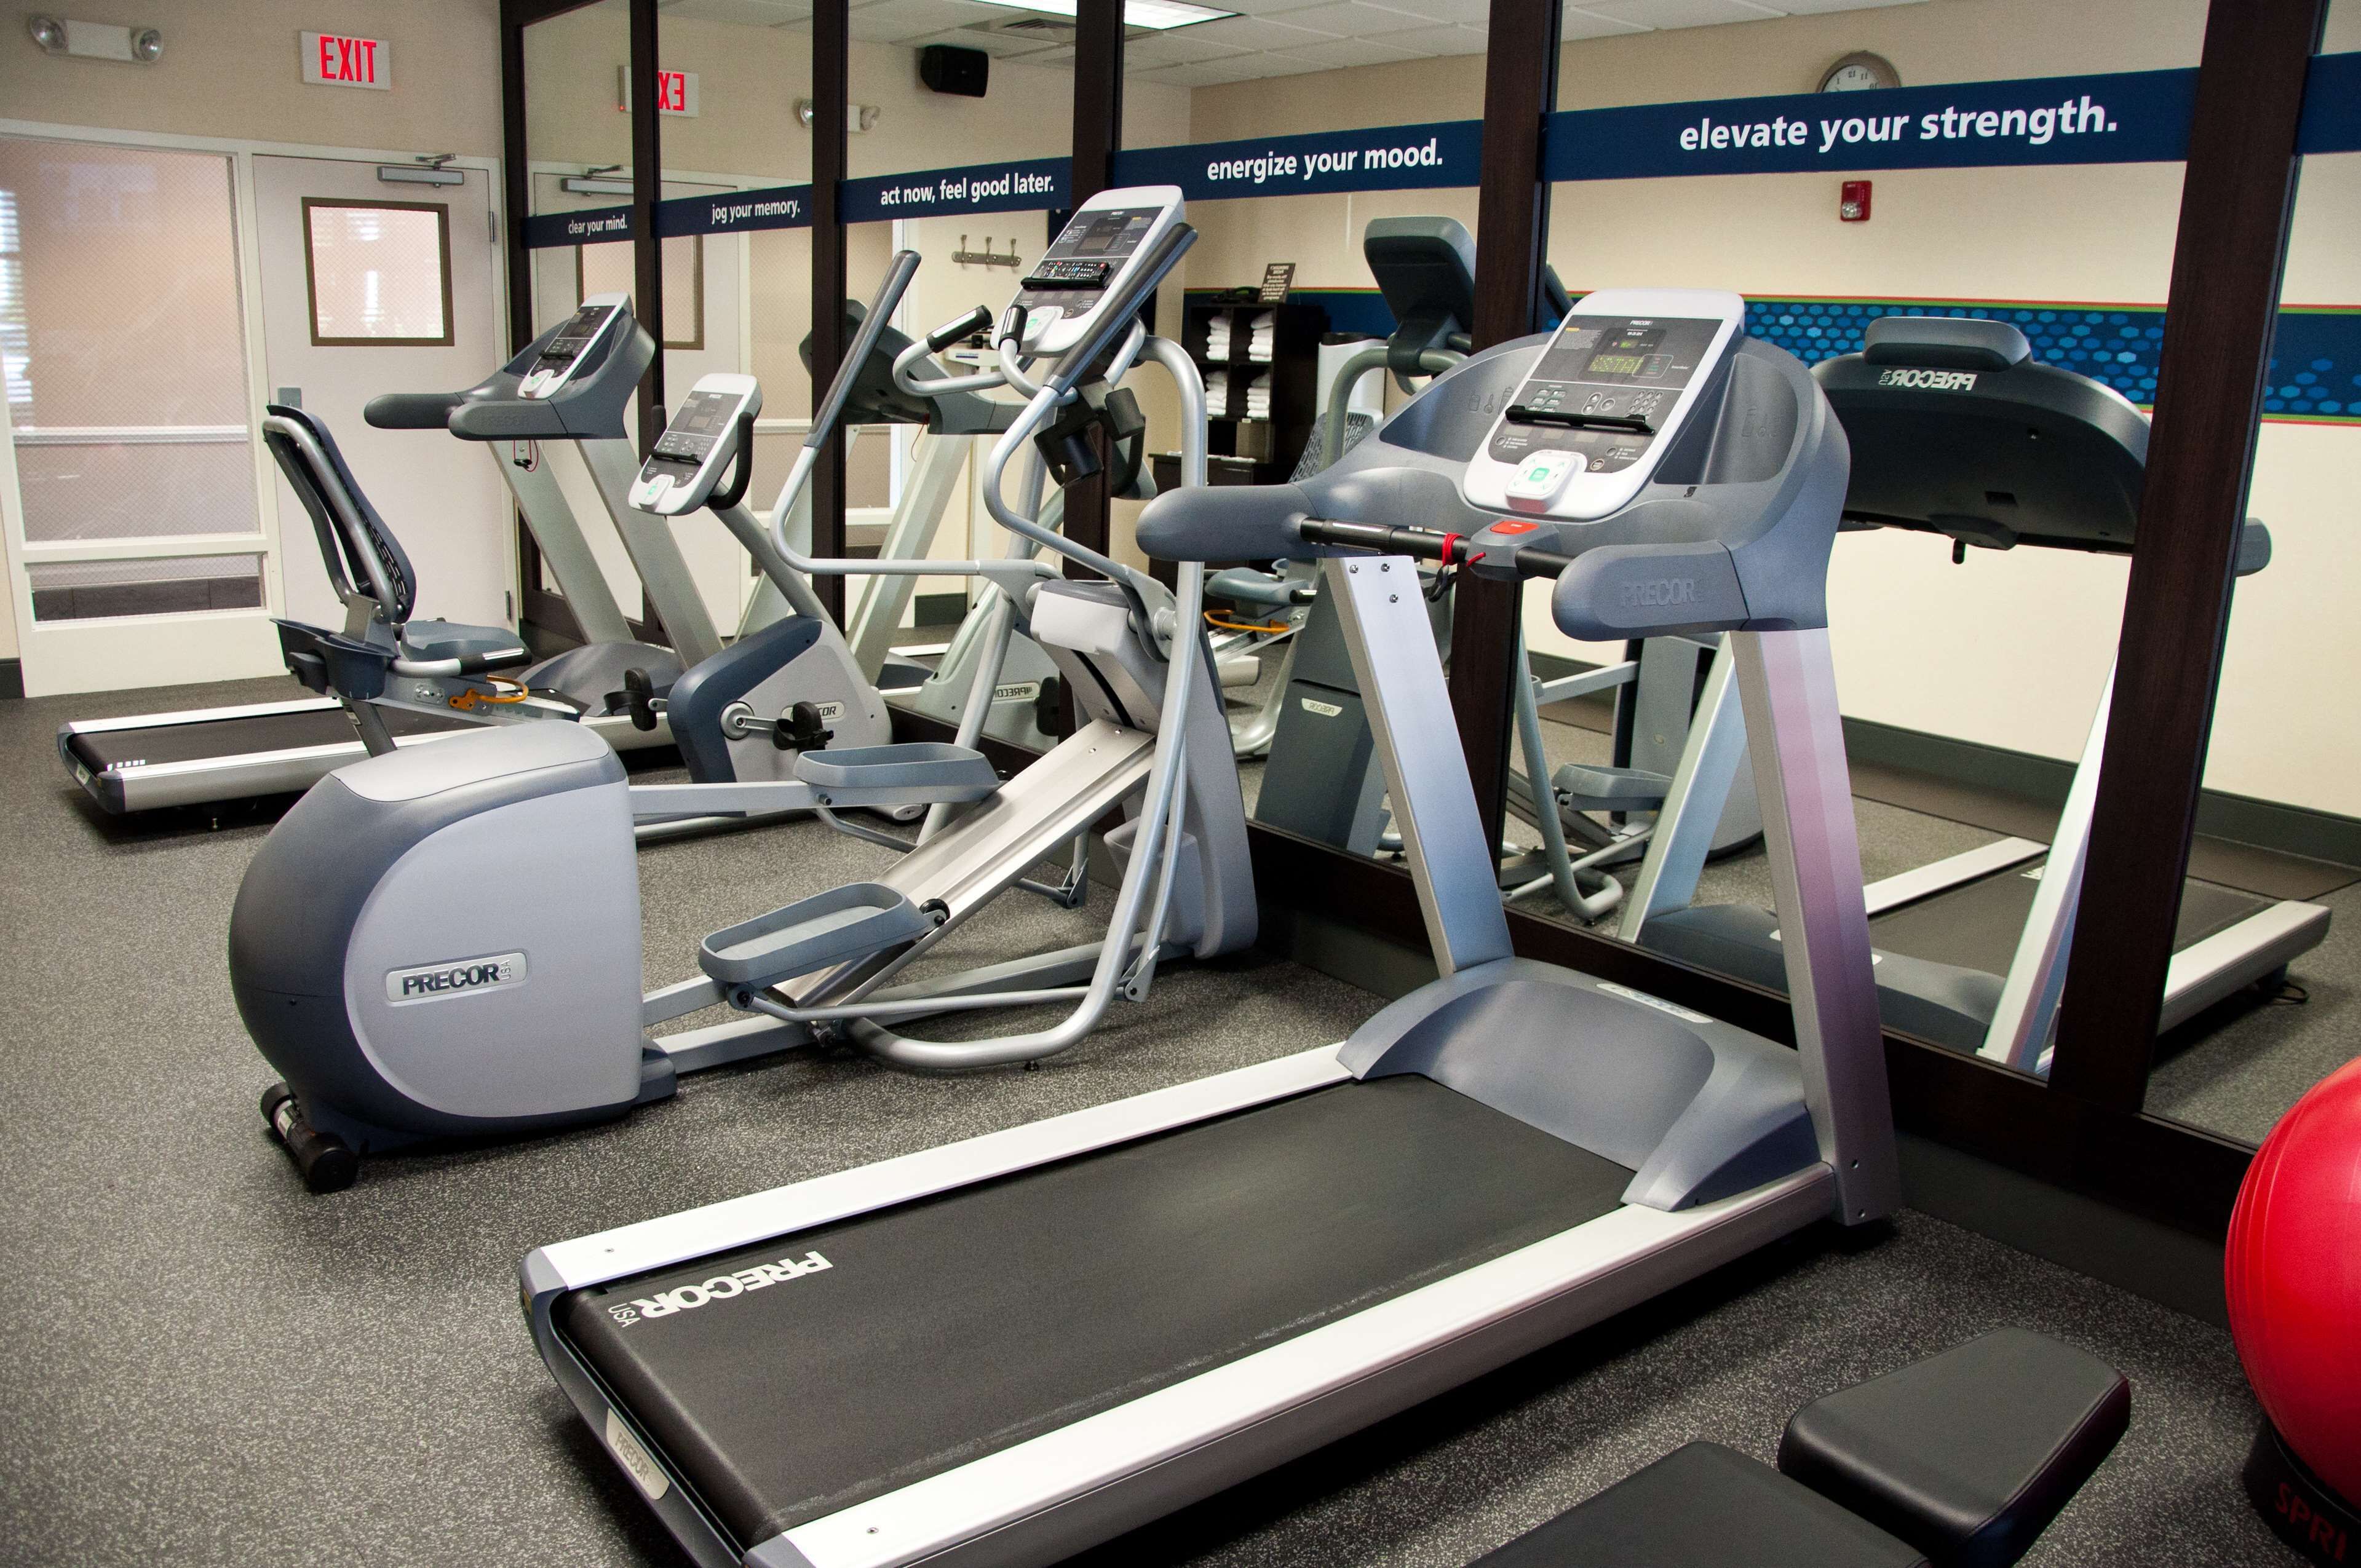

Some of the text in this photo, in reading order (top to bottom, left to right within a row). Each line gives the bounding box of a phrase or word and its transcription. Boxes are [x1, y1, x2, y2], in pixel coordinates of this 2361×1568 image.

[319, 35, 377, 83] EXIT
[1680, 95, 2117, 152] elevate your strength.
[1207, 138, 1443, 183] energize your mood.
[881, 172, 1054, 205] act now, feel good later.
[568, 213, 627, 237] clear your mind.
[712, 199, 800, 224] jog your memory.
[1619, 577, 1696, 607] PRECOR
[402, 959, 512, 996] PRECOR USA
[608, 1251, 833, 1328] PRECOR USA
[2276, 1482, 2347, 1562] SPRI
